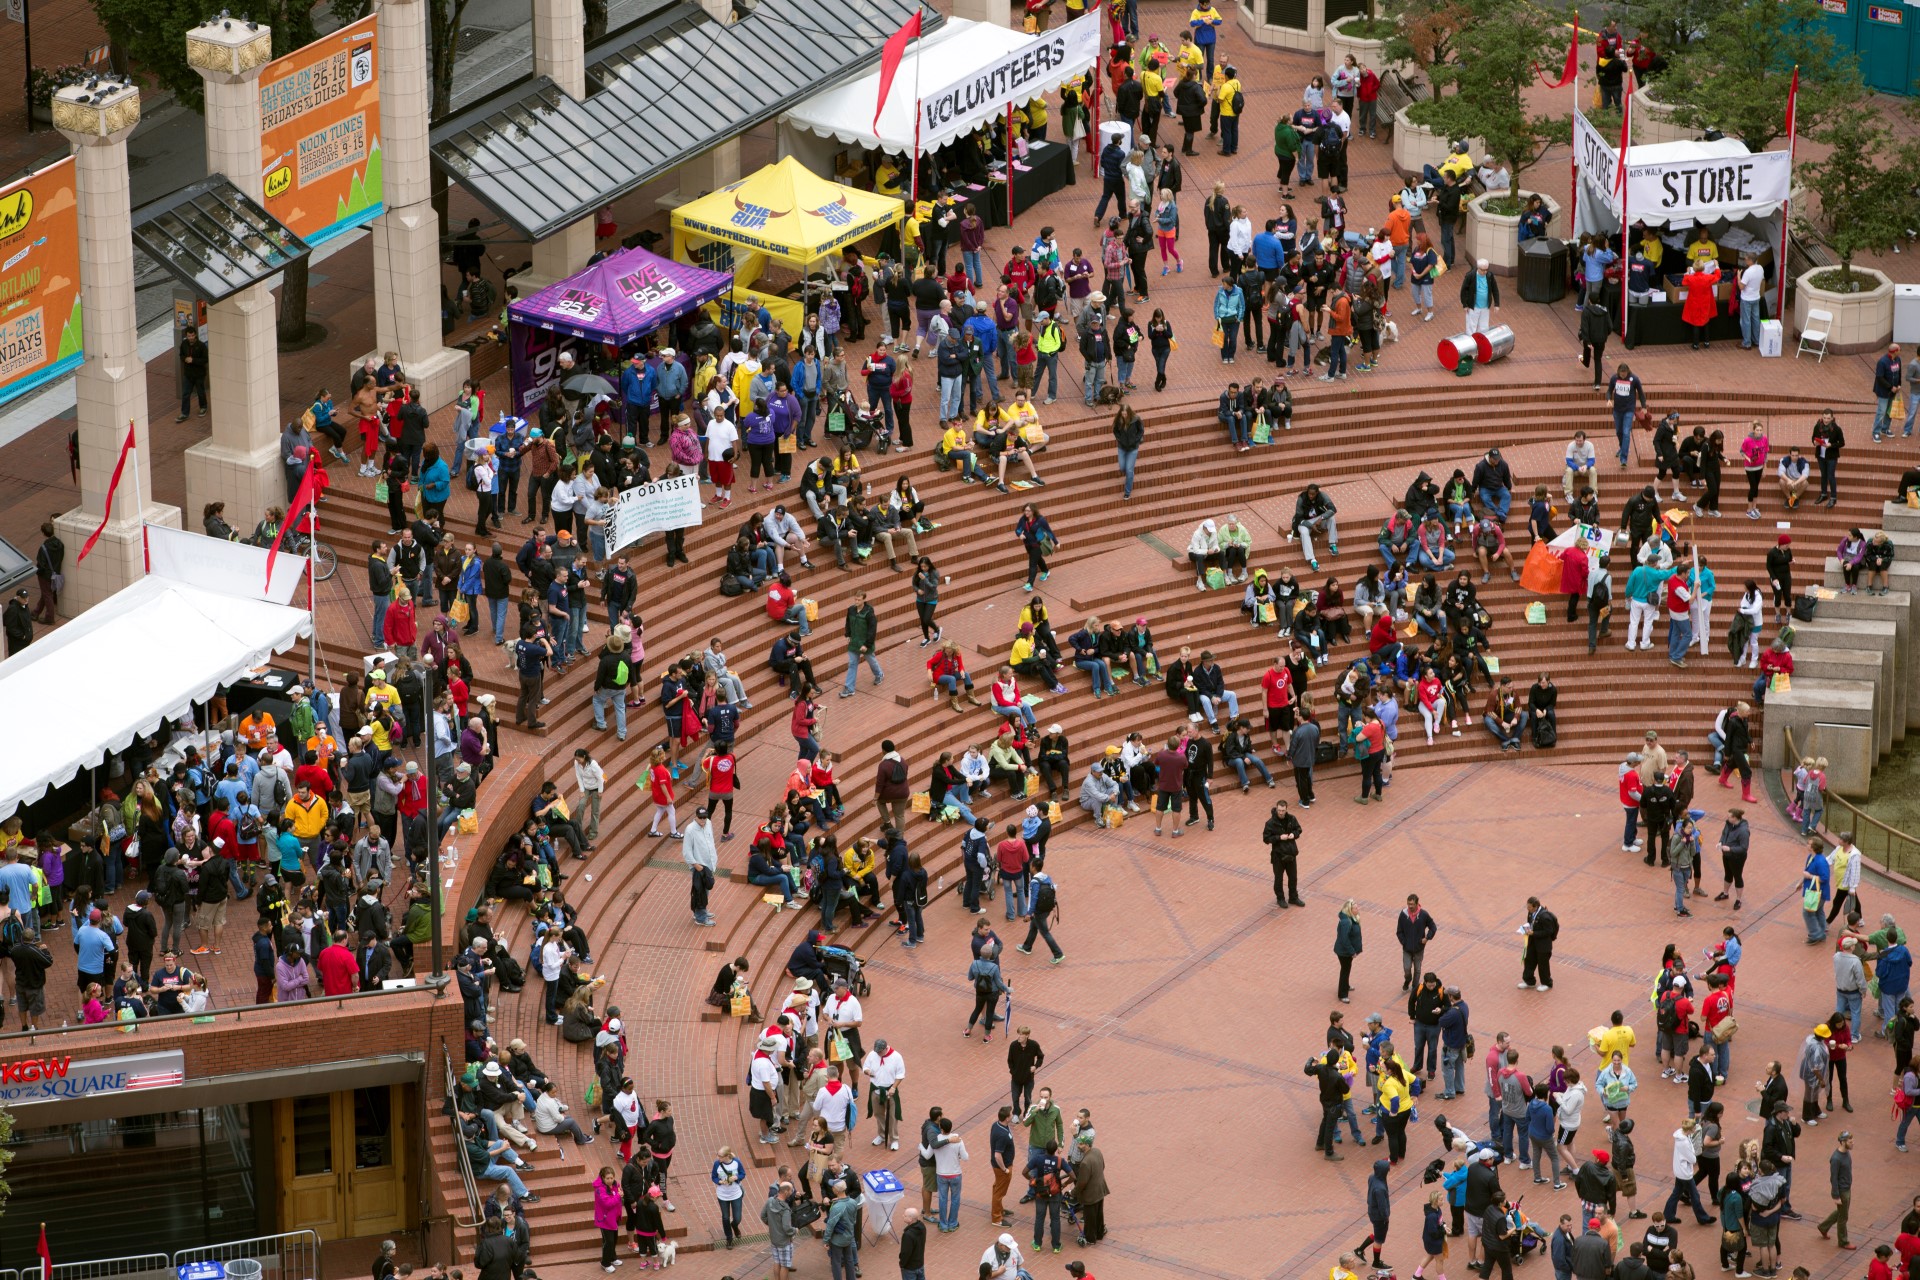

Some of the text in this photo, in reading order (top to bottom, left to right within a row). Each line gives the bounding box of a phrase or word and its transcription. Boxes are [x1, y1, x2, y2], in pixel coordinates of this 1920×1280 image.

[314, 51, 346, 73] JULY AUG
[261, 67, 312, 103] FLICKS ON
[926, 37, 1065, 130] VOLUNTEERS
[262, 82, 311, 115] THE BRICKS
[262, 100, 303, 131] FRIDAYS
[315, 80, 346, 106] DUSK
[300, 115, 363, 156] NOON TUNES
[300, 143, 333, 165] TUESDAYS
[300, 150, 338, 175] THURSDAYS
[1584, 132, 1613, 196] STORE
[268, 168, 288, 193] kink
[1629, 168, 1663, 178] AIDS WALK
[1661, 164, 1754, 208] STORE
[744, 203, 771, 218] THE
[816, 201, 842, 215] THE
[683, 217, 790, 255] WWW.987THEBULL.COM
[816, 211, 893, 255] WWW.987THEBULL.COM
[616, 262, 663, 297] LIVE
[632, 277, 678, 306] 95.5
[558, 288, 607, 309] LIVE
[558, 299, 600, 317] 95.5
[1, 349, 43, 375] SEPTEMBER
[638, 477, 695, 498] ODYSSEY
[2, 1056, 71, 1084] KGW
[25, 1085, 40, 1098] the
[41, 1072, 127, 1098] SQUARE
